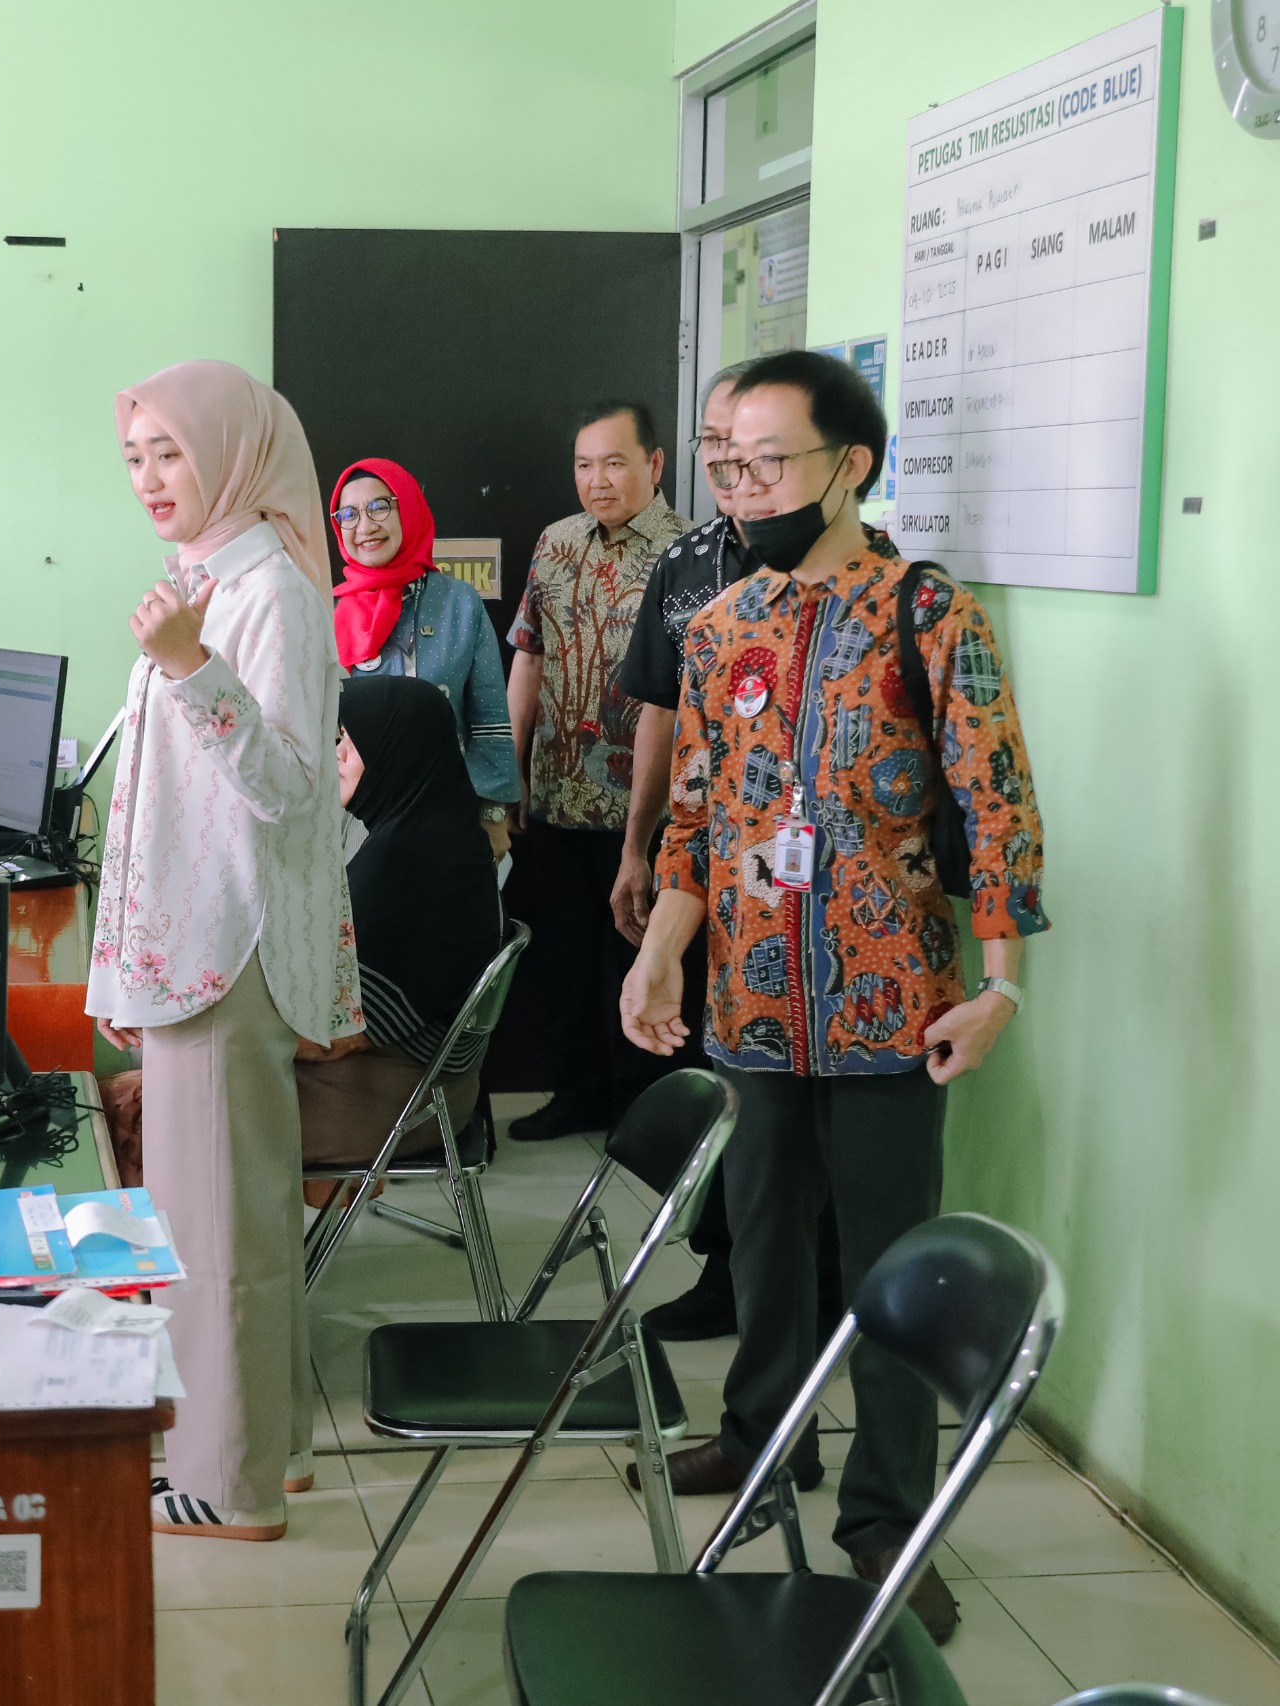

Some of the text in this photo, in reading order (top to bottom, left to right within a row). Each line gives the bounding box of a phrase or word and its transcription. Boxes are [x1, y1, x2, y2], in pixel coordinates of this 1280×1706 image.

[1256, 15, 1266, 42] 8
[918, 63, 1142, 175] PETUGAS TIM RESUSITASI (CODE BLUE)
[1031, 232, 1064, 260] SIANG
[1088, 211, 1136, 245] MALAM
[905, 337, 948, 362] LEADER
[904, 396, 954, 419] VENTILATOR
[903, 455, 953, 475] COMPRESOR
[901, 514, 950, 534] SIRKULATOR
